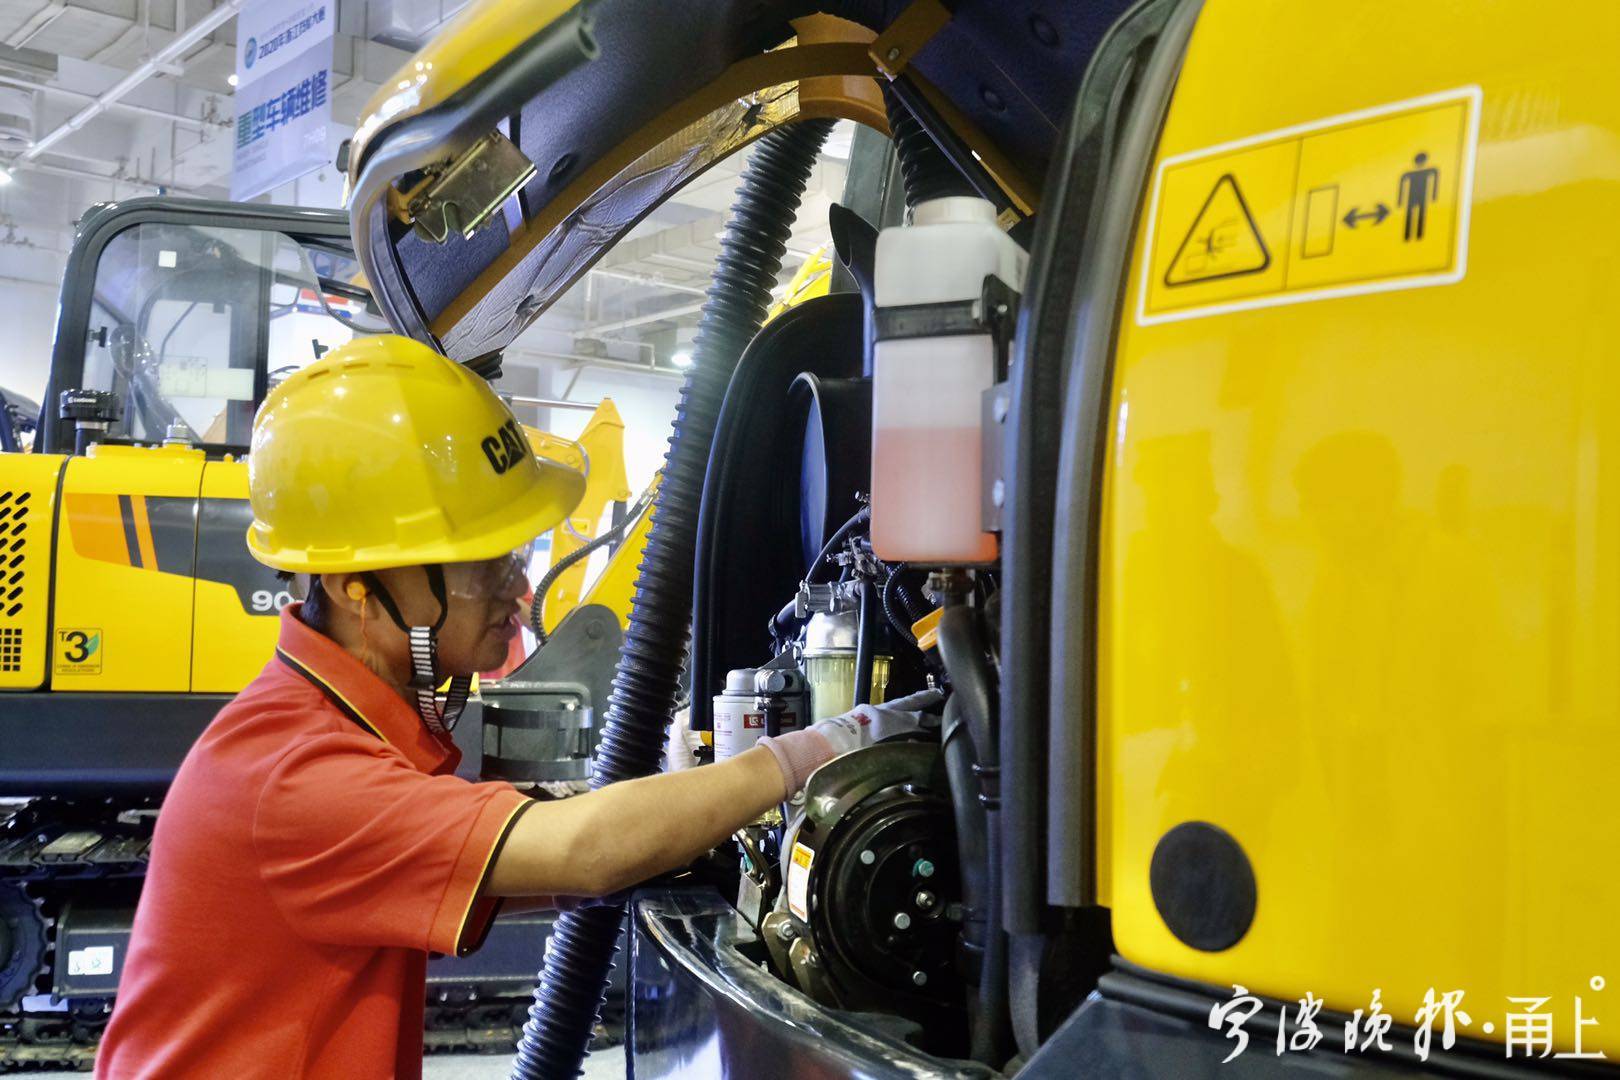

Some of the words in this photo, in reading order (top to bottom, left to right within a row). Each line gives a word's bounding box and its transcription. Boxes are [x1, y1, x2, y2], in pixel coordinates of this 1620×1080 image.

[236, 69, 328, 149] 重型车辆维修
[481, 418, 527, 475] CAT
